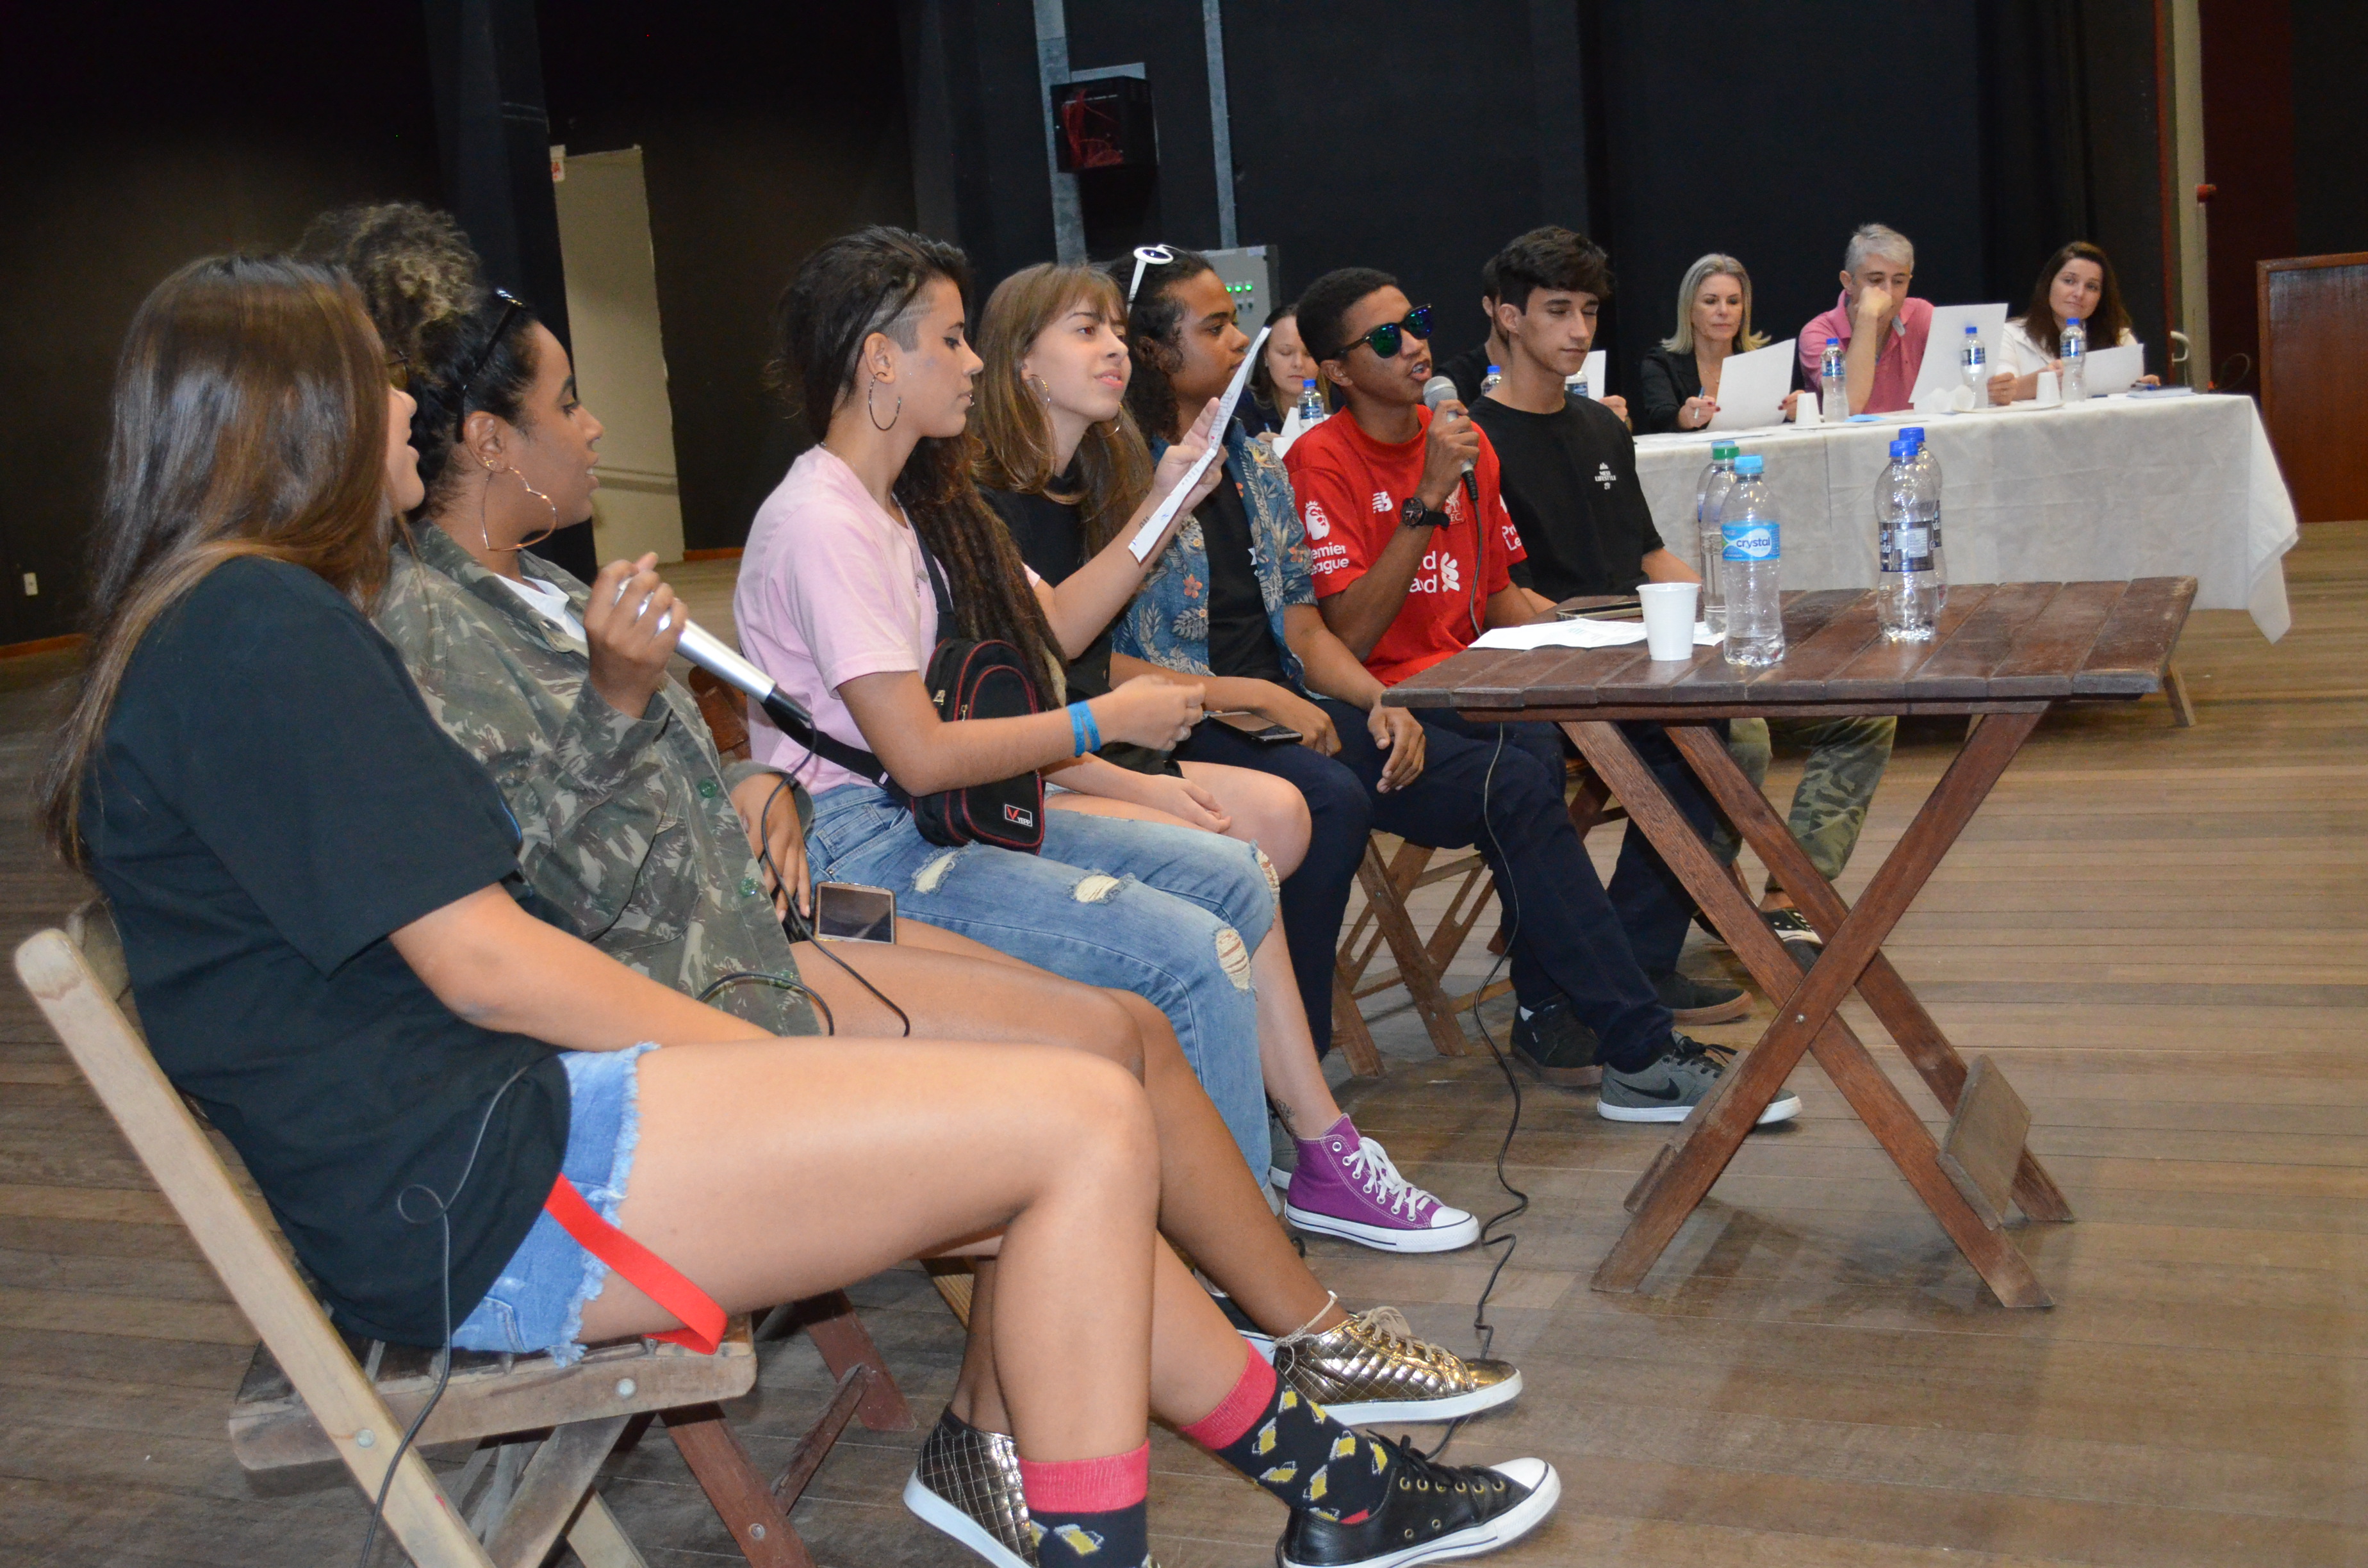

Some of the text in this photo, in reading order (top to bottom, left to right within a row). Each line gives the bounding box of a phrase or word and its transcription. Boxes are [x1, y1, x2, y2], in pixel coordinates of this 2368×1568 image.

[1310, 541, 1347, 560] emier
[1736, 536, 1771, 550] crystal
[1310, 558, 1350, 575] eague
